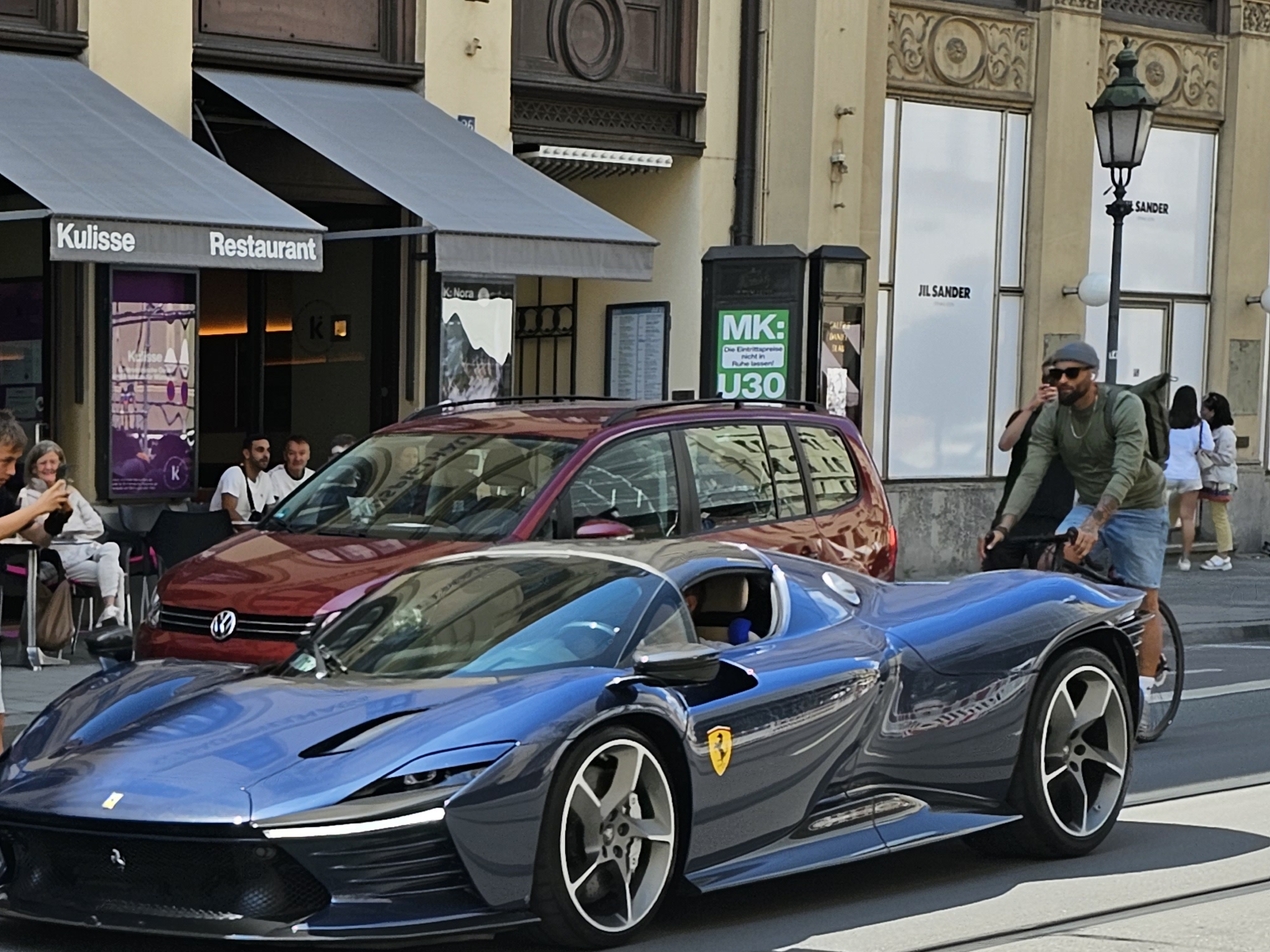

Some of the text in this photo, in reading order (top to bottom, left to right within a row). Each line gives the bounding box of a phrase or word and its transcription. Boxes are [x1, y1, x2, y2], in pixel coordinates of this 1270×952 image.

[1135, 200, 1169, 214] SANDER
[56, 222, 317, 261] Kulisse Restaurant
[454, 288, 474, 298] Nora
[918, 284, 971, 300] JIL SANDER
[723, 314, 785, 340] MK:
[717, 372, 786, 399] U30
